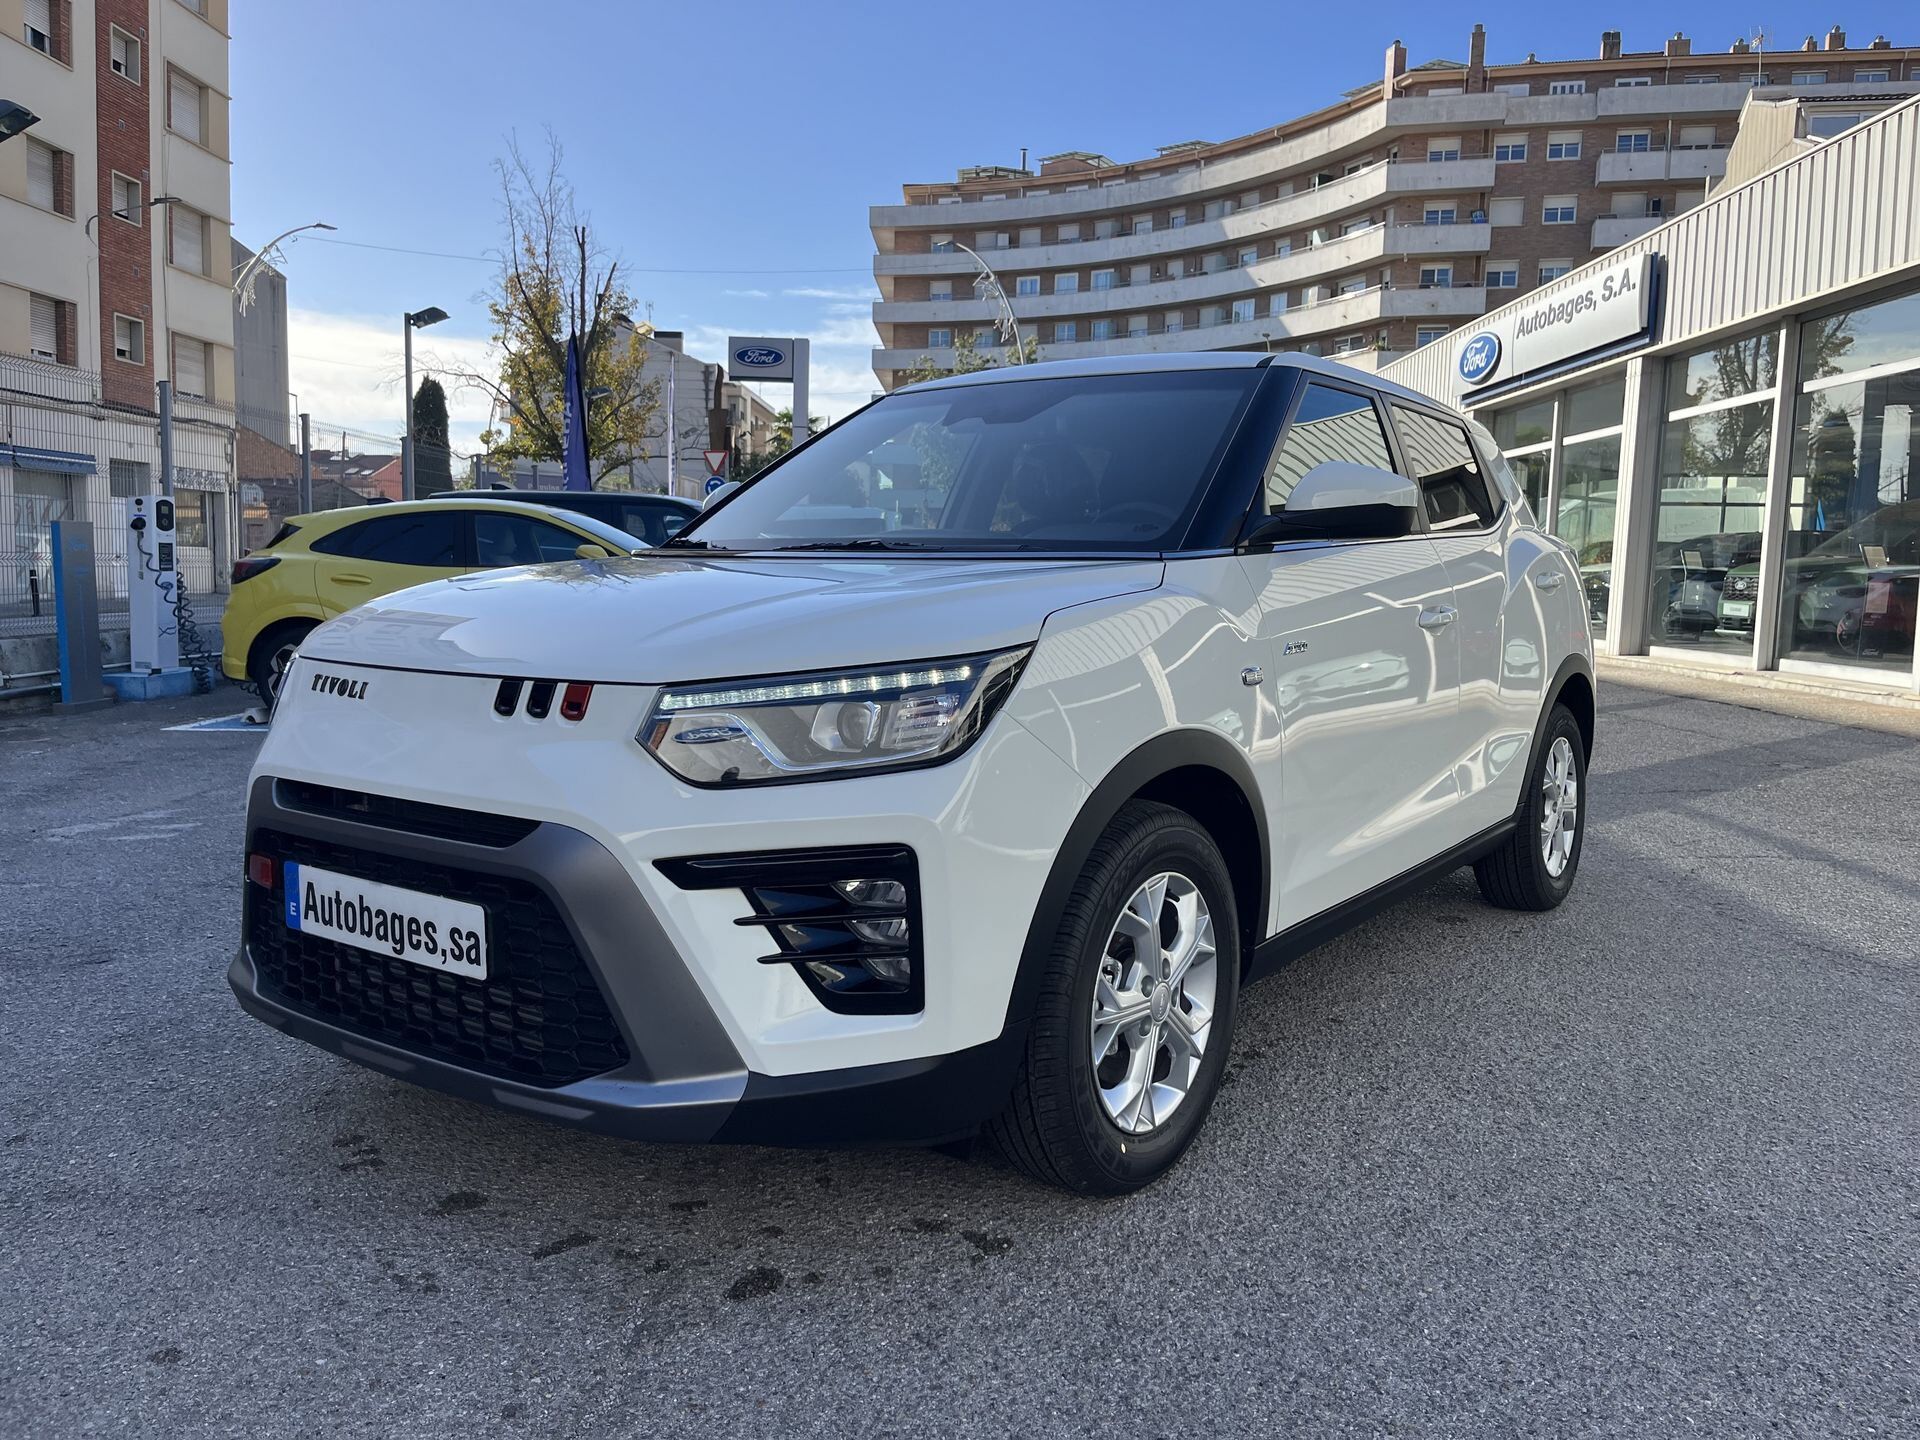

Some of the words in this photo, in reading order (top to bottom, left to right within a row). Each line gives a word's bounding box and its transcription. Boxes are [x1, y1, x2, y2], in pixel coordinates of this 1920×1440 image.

[1516, 289, 1597, 340] Autobages,
[1601, 267, 1636, 302] S.A.
[744, 349, 776, 363] Ford
[1463, 340, 1487, 373] Ford
[311, 673, 369, 700] TIVOLI
[289, 901, 297, 916] E
[303, 881, 482, 967] Autobages,sa
